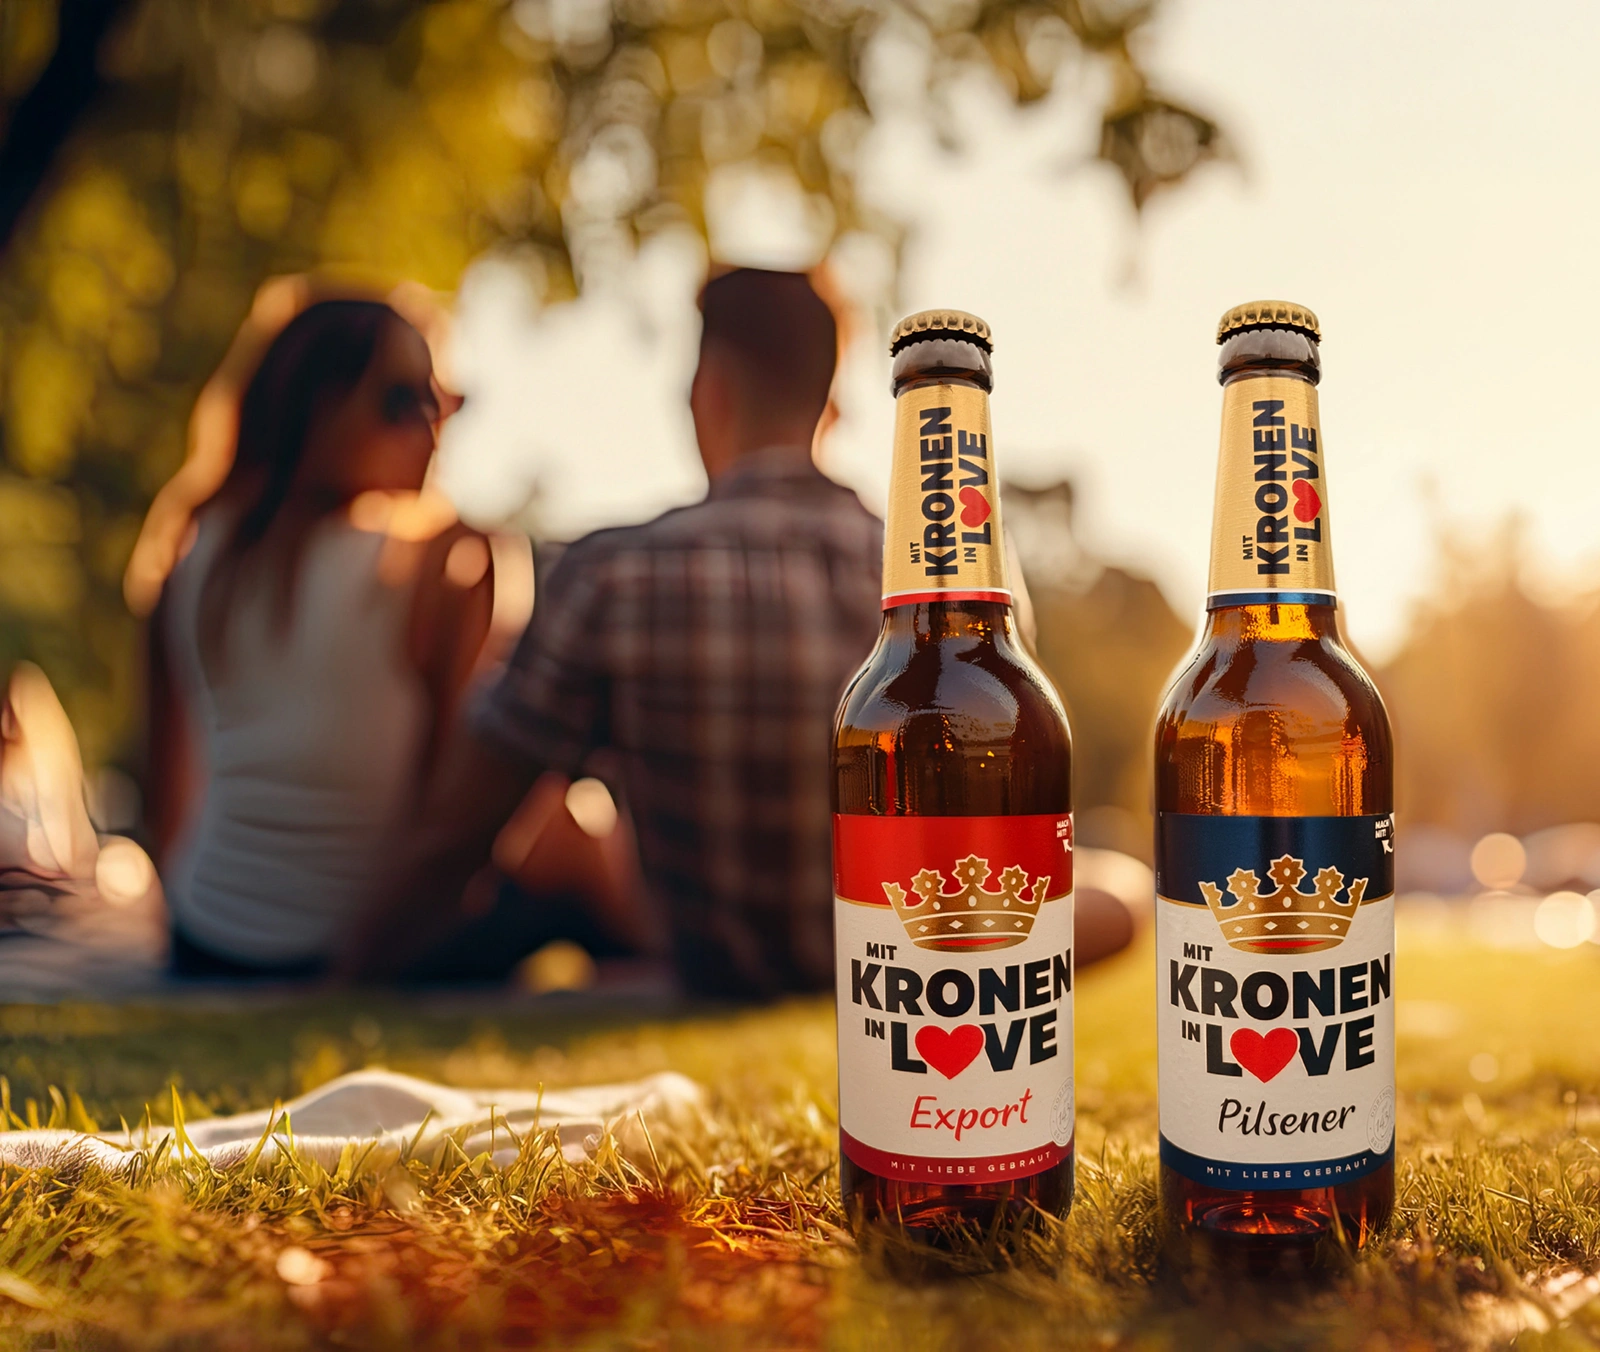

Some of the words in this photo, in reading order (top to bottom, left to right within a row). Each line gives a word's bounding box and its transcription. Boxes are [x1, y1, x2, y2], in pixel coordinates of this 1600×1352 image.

[919, 406, 959, 576] KRONEN
[1252, 399, 1290, 575] KRONEN
[910, 541, 921, 564] MIT
[964, 547, 977, 563] IN
[1242, 535, 1253, 560] MIT
[1296, 544, 1309, 562] IN
[865, 941, 898, 961] MIT
[1183, 941, 1214, 962] MIT
[850, 947, 1072, 1018] KRONEN
[1169, 952, 1392, 1021] KRONEN
[864, 1016, 886, 1041] IN
[1181, 1019, 1201, 1043] IN
[909, 1087, 1034, 1142] Export
[1216, 1097, 1357, 1137] Pilsener
[890, 1160, 916, 1173] MIT
[926, 1164, 977, 1175] LIEBE
[987, 1150, 1052, 1174] GEBRAUT
[1206, 1165, 1232, 1178] MIT
[1242, 1169, 1293, 1179] LIEBE
[1303, 1157, 1368, 1178] GEBRAUT
